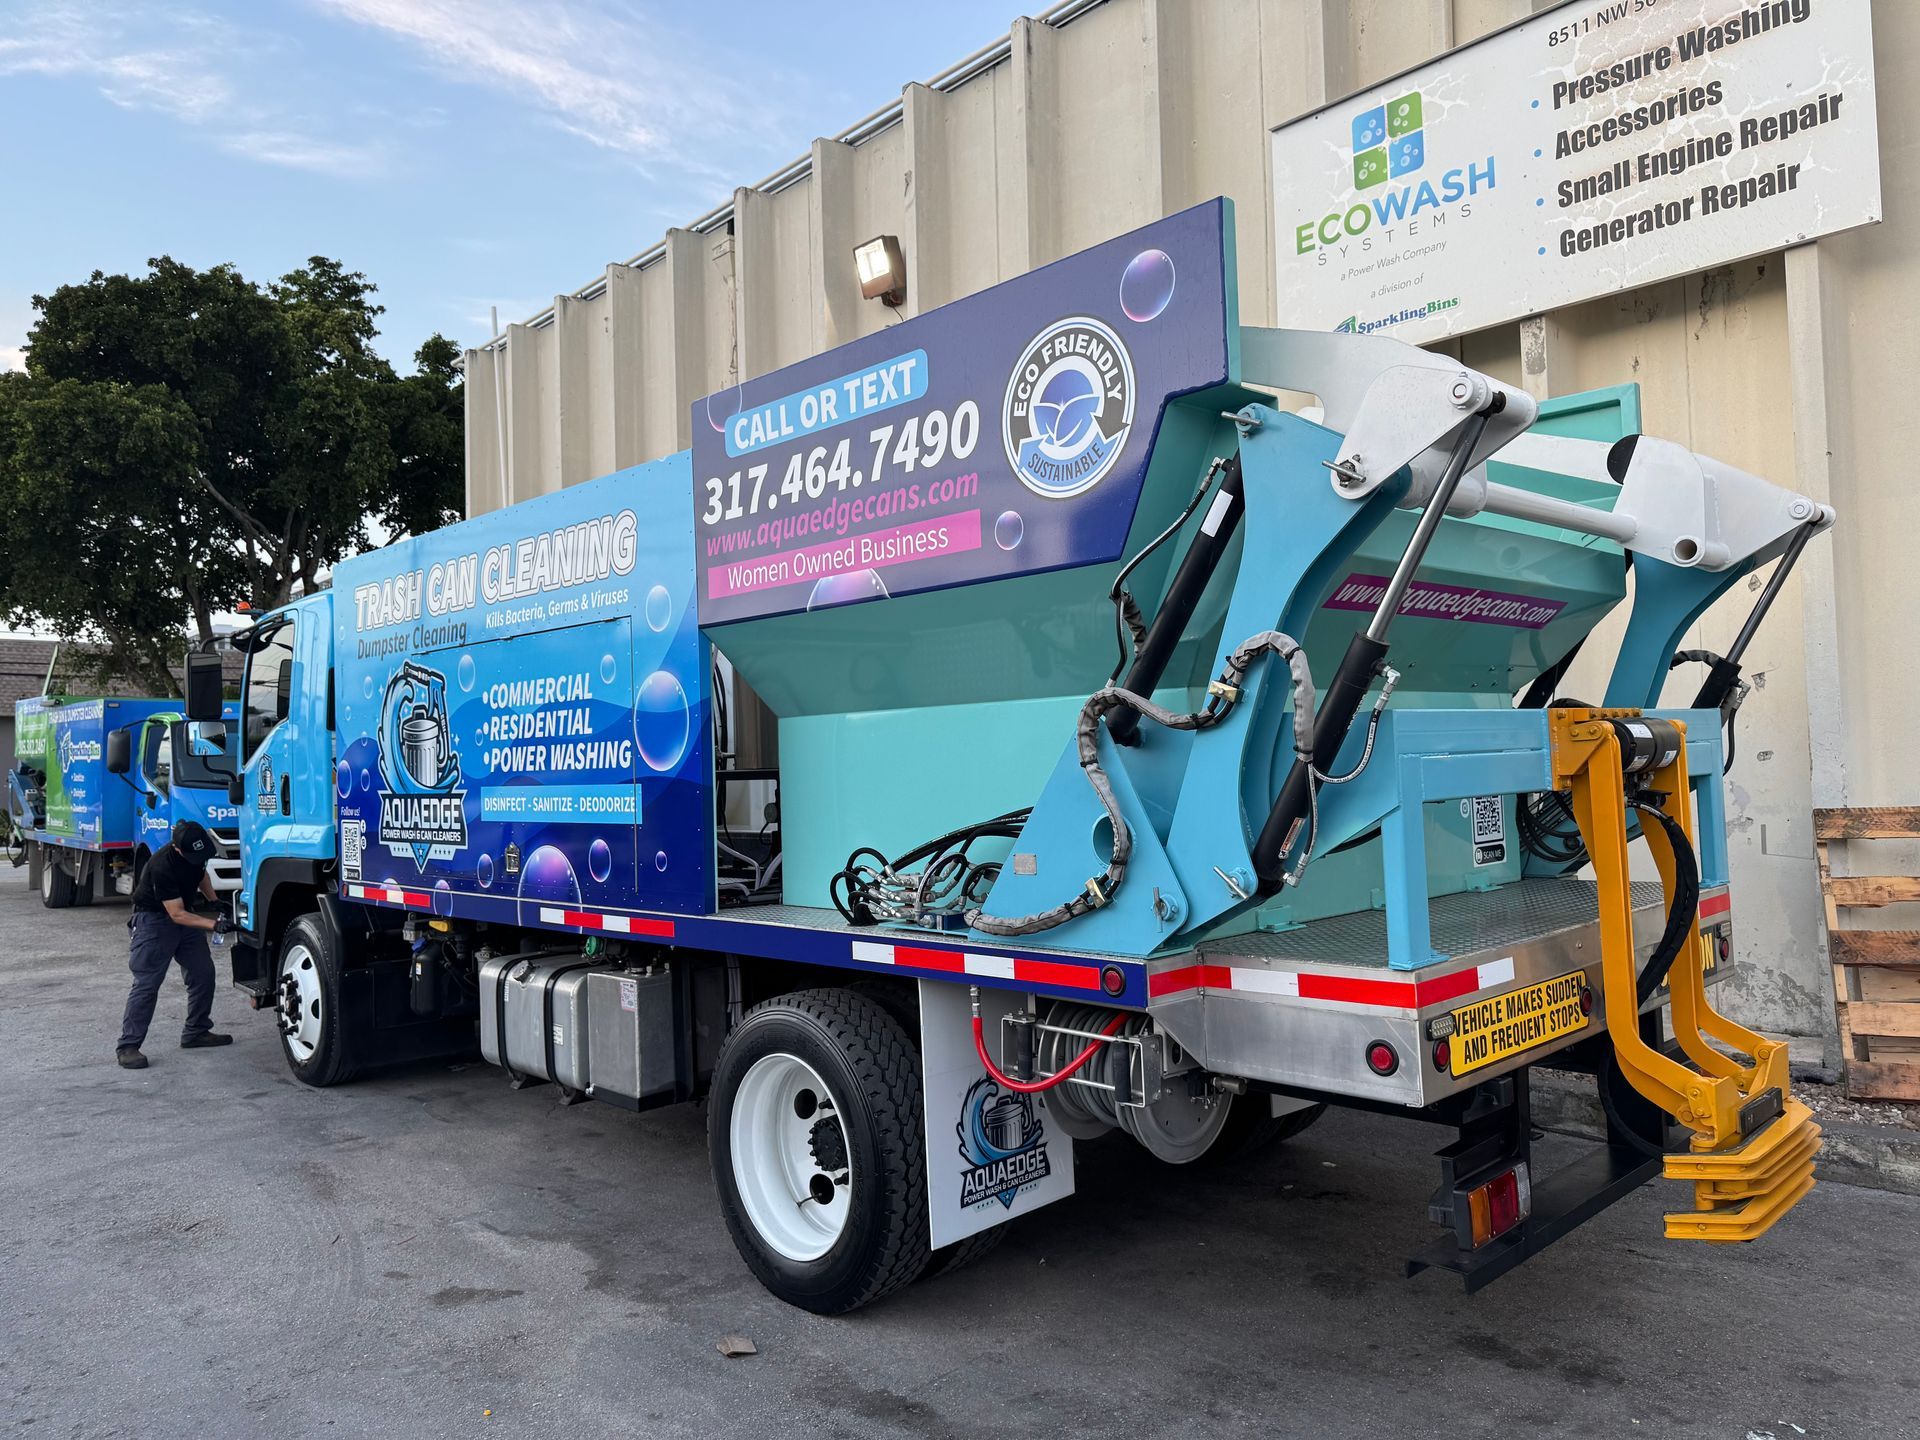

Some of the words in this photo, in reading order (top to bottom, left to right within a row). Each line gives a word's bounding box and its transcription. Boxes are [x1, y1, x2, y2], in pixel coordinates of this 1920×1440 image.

[1548, 17, 1589, 47] 8511
[1596, 1, 1629, 28] NW
[1634, 0, 1657, 13] 5
[1552, 46, 1672, 110] Pressure
[1676, 0, 1812, 63] Washing
[1555, 80, 1723, 160] Accessories
[1557, 159, 1631, 208] Small
[1637, 131, 1732, 183] Engine
[1739, 92, 1844, 150] Repair
[1296, 155, 1496, 255] ECOWASH
[1560, 196, 1695, 258] Generator
[1701, 163, 1801, 216] Repair
[1318, 204, 1472, 266] SYSTEMS
[1340, 272, 1346, 281] a
[1348, 264, 1375, 280] Power
[1376, 254, 1401, 269] Wash
[1402, 240, 1447, 261] Company
[1370, 289, 1377, 299] a
[1377, 279, 1413, 296] division
[1413, 272, 1425, 285] of
[1357, 296, 1460, 334] SparklingBins
[1013, 363, 1040, 417] ECO
[1041, 333, 1122, 401] FRIENDLY
[734, 404, 794, 450] CALL
[800, 388, 838, 429] OR
[844, 358, 916, 414] TEXT
[702, 399, 981, 526] 317.464.7490
[1027, 442, 1104, 482] SUSTAINABLE
[706, 472, 979, 558] www.aquaedgecans.com
[353, 568, 424, 633] TRASH
[427, 552, 478, 617] CAN
[481, 508, 639, 605] CLEANING
[727, 560, 789, 590] Women
[793, 539, 855, 573] Owned
[861, 526, 949, 564] Business
[486, 612, 503, 629] Kills
[505, 602, 546, 624] Bacteria,
[548, 598, 579, 616] Germs
[581, 593, 589, 610] &
[591, 588, 629, 609] Viruses
[1334, 583, 1556, 624] wwwquaedgecans.com
[357, 632, 409, 661] Dumpster
[412, 621, 467, 648] Cleaning
[489, 672, 593, 710] COMMERCIAL
[490, 707, 593, 741] RESIDENTIAL
[490, 745, 547, 773] POWER
[550, 739, 632, 772] WASHING
[383, 798, 461, 829] AQUAEDGE
[484, 797, 526, 812] DISINFECT
[533, 797, 572, 812] SANITIZE
[580, 796, 637, 812] DEODORIZE
[383, 829, 400, 838] POWER
[401, 830, 416, 839] WASH
[420, 830, 432, 840] CAN
[433, 831, 461, 841] CLEANERS
[1454, 1001, 1502, 1037] VEHICLE
[1506, 988, 1543, 1019] MAKES
[1546, 975, 1582, 1006] SUDDEN
[1464, 1034, 1487, 1064] AND
[1491, 1013, 1546, 1053] FREQUENT
[1550, 1002, 1580, 1032] STOPS
[964, 1147, 1045, 1196] AQUAEDGE
[964, 1191, 985, 1204] POWER
[985, 1185, 1001, 1196] WASH
[1008, 1179, 1018, 1188] CAN
[1019, 1168, 1046, 1184] CLEANERS
